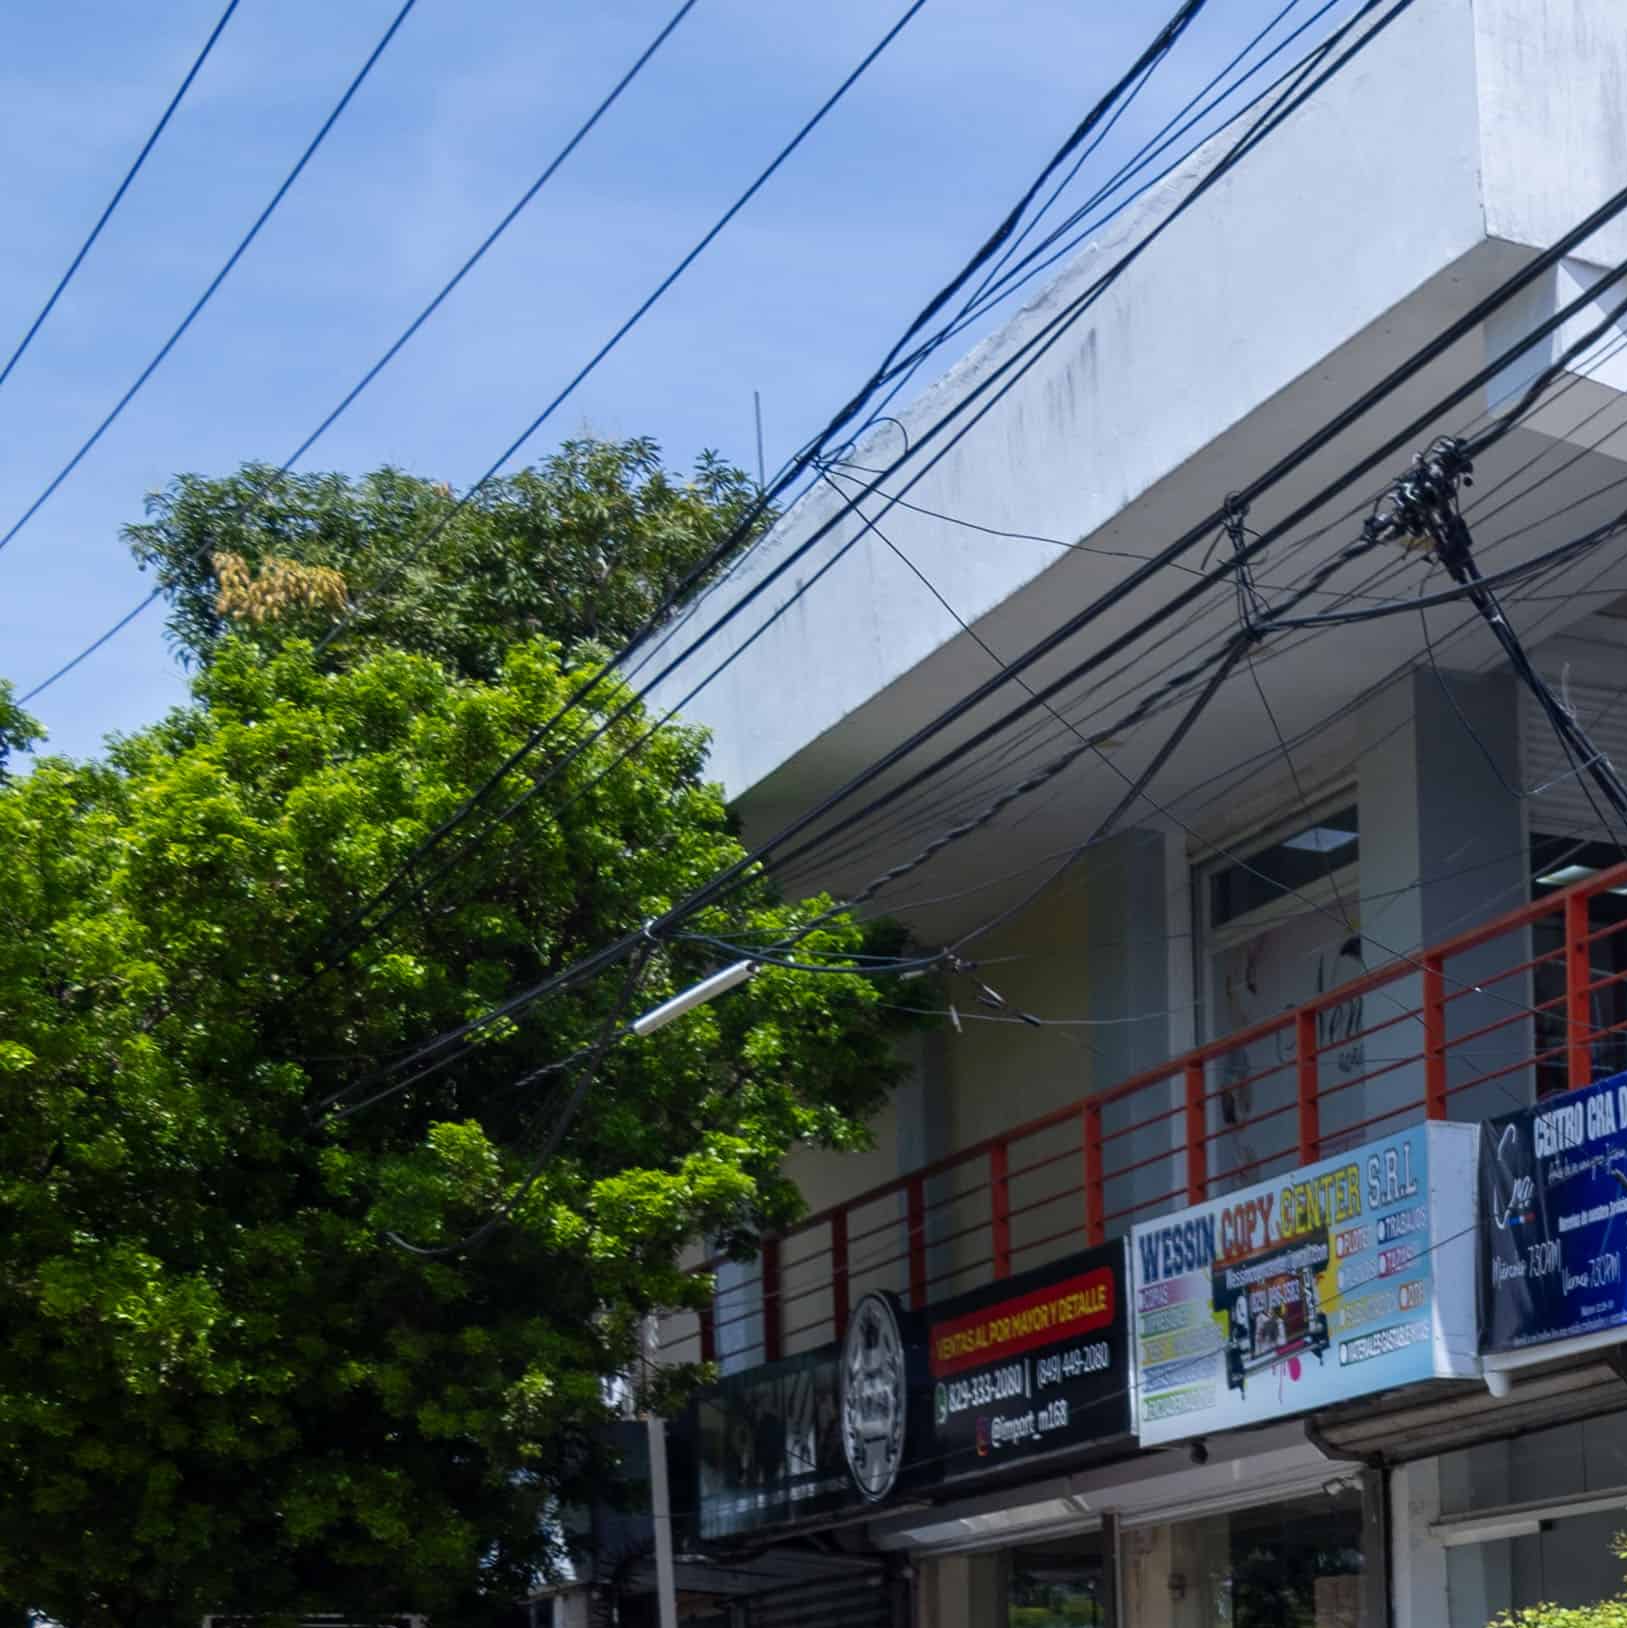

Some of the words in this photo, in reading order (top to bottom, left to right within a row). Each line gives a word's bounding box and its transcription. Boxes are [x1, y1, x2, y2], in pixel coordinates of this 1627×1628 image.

[1533, 1101, 1584, 1160] CENTRO
[1138, 1212, 1216, 1285] WESSIN
[1280, 1162, 1363, 1239] CENTER
[936, 1327, 975, 1360] VENTAS
[1011, 1304, 1049, 1336] MAYOR
[1058, 1284, 1107, 1323] DETALLE
[949, 1363, 1022, 1412] 829-333-2080
